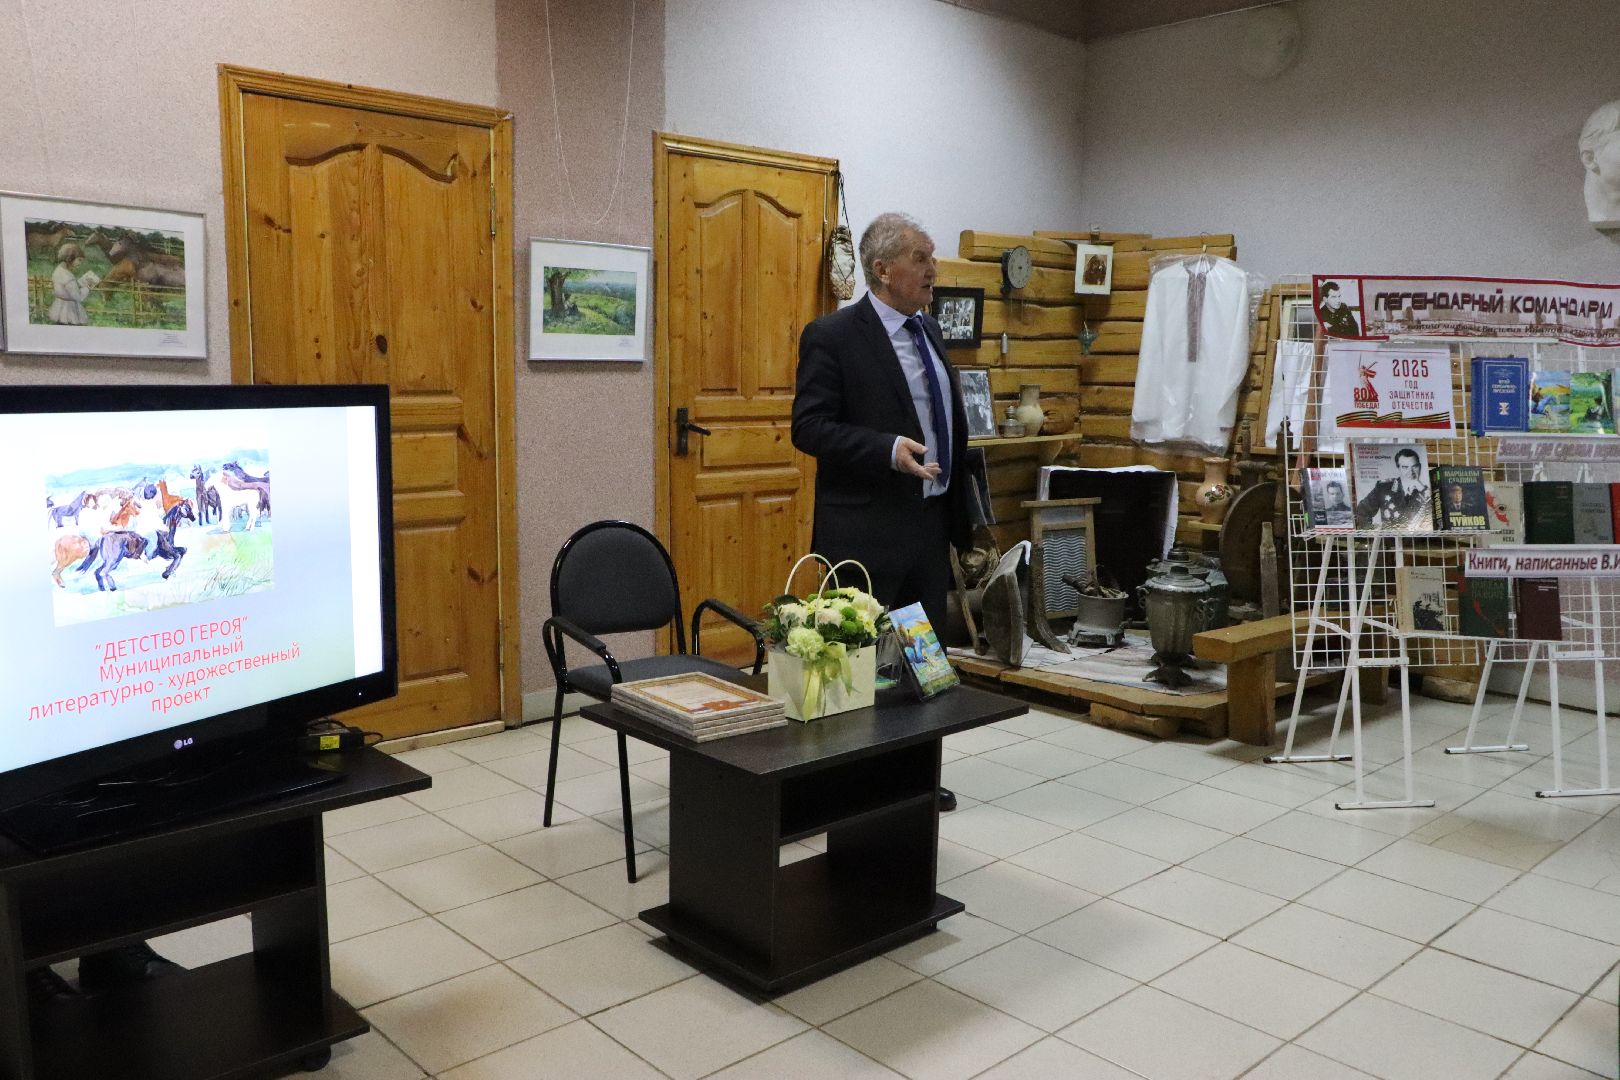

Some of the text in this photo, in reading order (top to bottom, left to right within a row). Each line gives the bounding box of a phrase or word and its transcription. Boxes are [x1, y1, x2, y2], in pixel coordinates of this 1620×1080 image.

[1374, 288, 1613, 319] ЛЕГЕНДАРНЫЙ КОМАНДАРМ
[1392, 359, 1429, 377] 2025
[1353, 387, 1367, 400] 80
[1404, 380, 1418, 389] ГОД
[1389, 390, 1435, 400] ЗАЩИТНИКА
[1391, 401, 1434, 410] ОТЕЧЕСТВА
[1449, 514, 1486, 526] ЧУЙКОВ
[1468, 553, 1511, 574] Книги,
[1515, 556, 1598, 571] написанные
[100, 636, 244, 683] Муниципальный
[28, 679, 154, 721] литературно
[167, 642, 300, 690] художественный
[151, 686, 211, 714] проект
